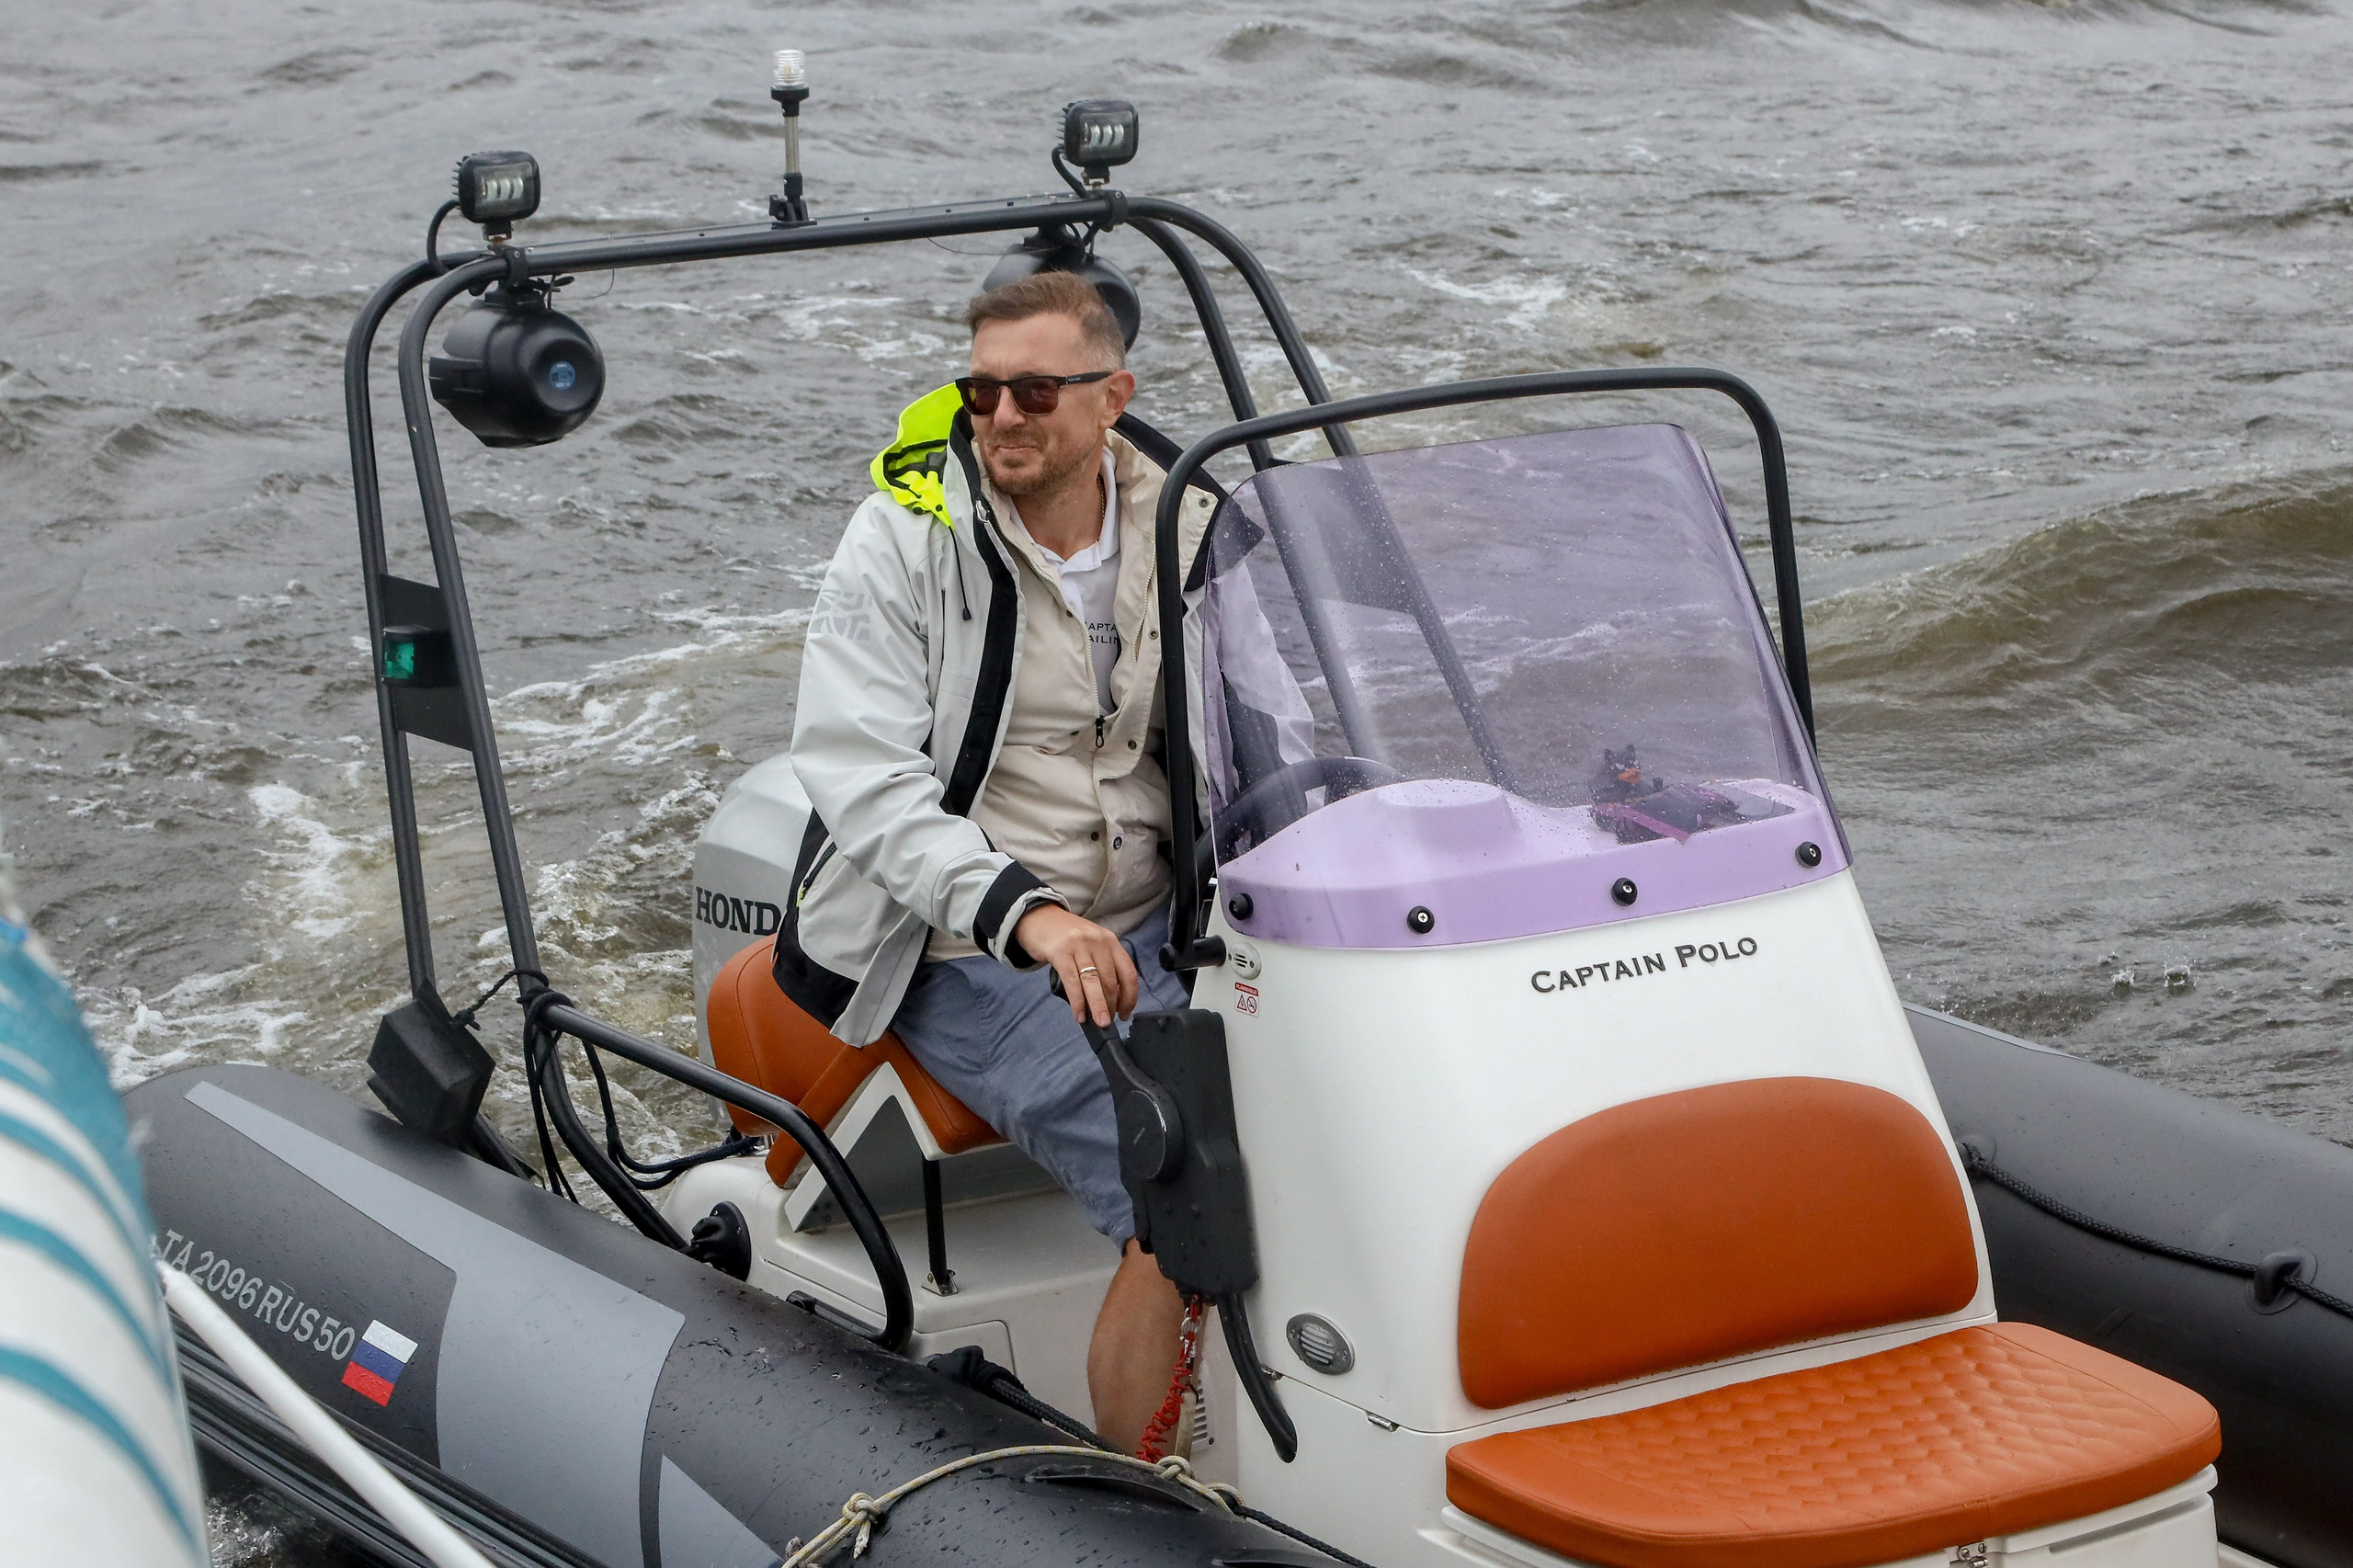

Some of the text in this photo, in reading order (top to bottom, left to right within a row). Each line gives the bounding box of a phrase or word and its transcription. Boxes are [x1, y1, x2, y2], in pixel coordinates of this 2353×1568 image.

[1086, 621, 1118, 631] APTA
[696, 886, 781, 936] HOND
[1531, 937, 1757, 993] CAPTAIN POLO
